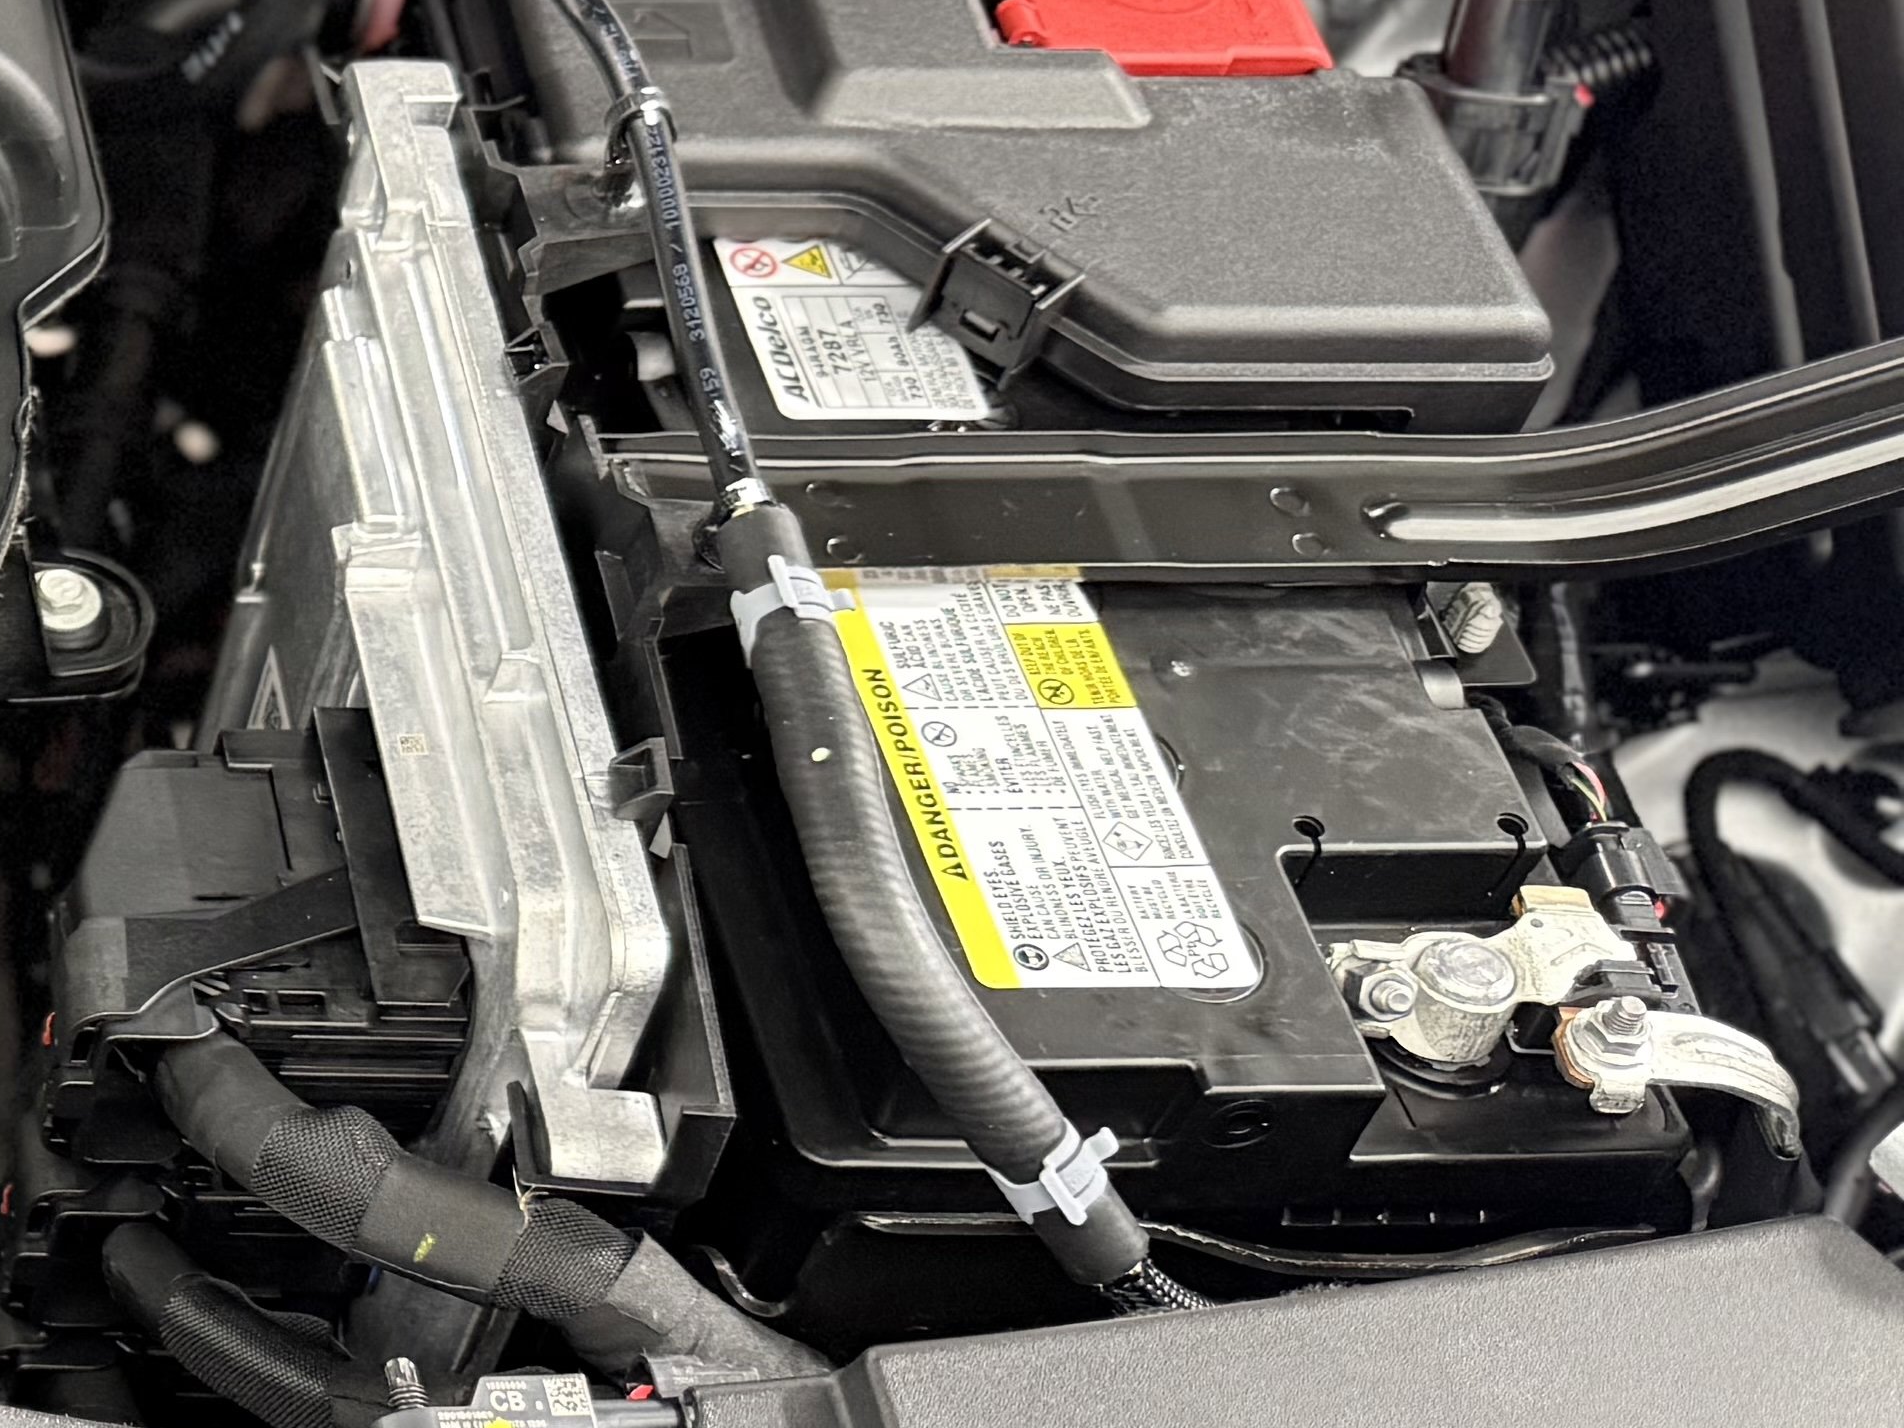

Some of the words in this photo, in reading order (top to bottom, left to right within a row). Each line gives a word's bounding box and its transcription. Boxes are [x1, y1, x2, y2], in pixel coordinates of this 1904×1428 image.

[870, 302, 893, 324] 730
[743, 295, 811, 403] ACDelco
[815, 329, 854, 374] 7287
[837, 320, 867, 356] VRLA
[885, 335, 910, 366] 80Ah
[855, 361, 878, 381] 12V
[902, 376, 925, 399] 730
[1001, 604, 1021, 617] DO
[877, 621, 912, 668] SULFURIC
[898, 624, 917, 642] CAN
[912, 619, 945, 669] BLINDNESS
[939, 607, 978, 663] SULFURIQUE
[967, 625, 984, 636] LA
[904, 645, 928, 668] ACID
[943, 652, 968, 685] SEVERE
[973, 639, 1001, 674] CAUSER
[935, 673, 959, 701] CAUSE
[990, 677, 1012, 700] PEUT
[1003, 668, 1021, 684] DES
[958, 689, 975, 700] OR
[1012, 723, 1043, 766] FLAMMES
[862, 668, 960, 858] DANGER/POISON
[1018, 770, 1037, 786] LES
[1032, 770, 1052, 786] LES
[1051, 777, 1067, 786] DE
[1051, 817, 1083, 861] PEUVENT
[1069, 819, 1101, 863] AVEUGLE
[987, 840, 1016, 875] GASES
[1034, 866, 1053, 879] OR
[1090, 867, 1119, 906] RENDRE
[1024, 884, 1051, 915] CAUSE
[1064, 892, 1087, 912] LES
[1070, 864, 1110, 924] EXPLOSIFS
[995, 901, 1026, 939] SHIELD
[1003, 879, 1044, 939] EXPLOSIVE
[1041, 883, 1078, 939] BLINDNESS
[1108, 910, 1127, 923] OU
[1038, 918, 1061, 939] CAN
[1098, 928, 1122, 949] GAZ
[1109, 953, 1132, 972] LES
[1116, 927, 1148, 972] BLESSER
[489, 1390, 526, 1411] CB
